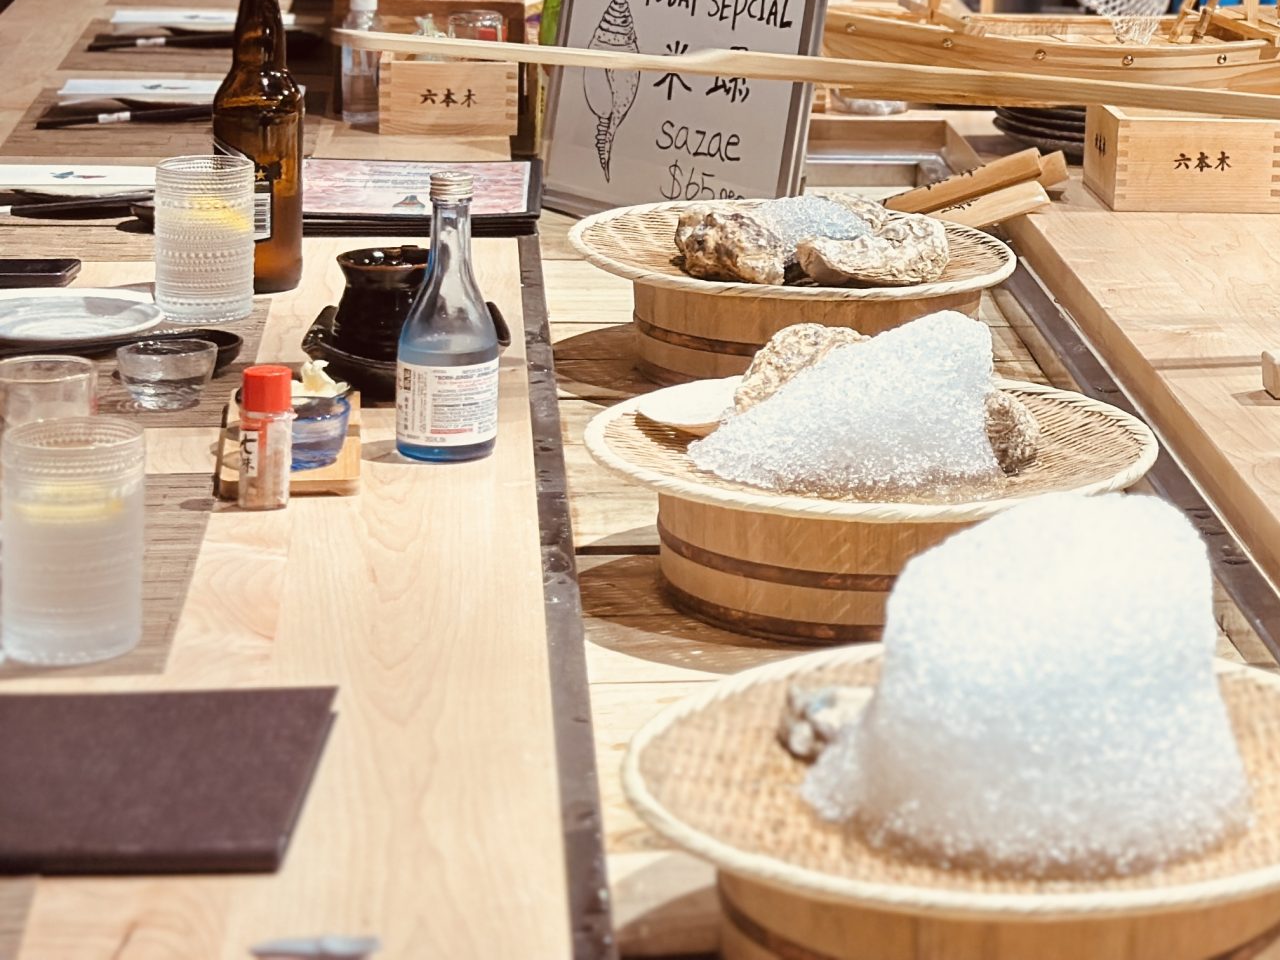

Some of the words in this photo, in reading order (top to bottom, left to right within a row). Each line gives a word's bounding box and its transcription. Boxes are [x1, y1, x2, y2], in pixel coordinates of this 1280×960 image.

[420, 88, 478, 108] 六本木
[1173, 150, 1232, 172] 六本木
